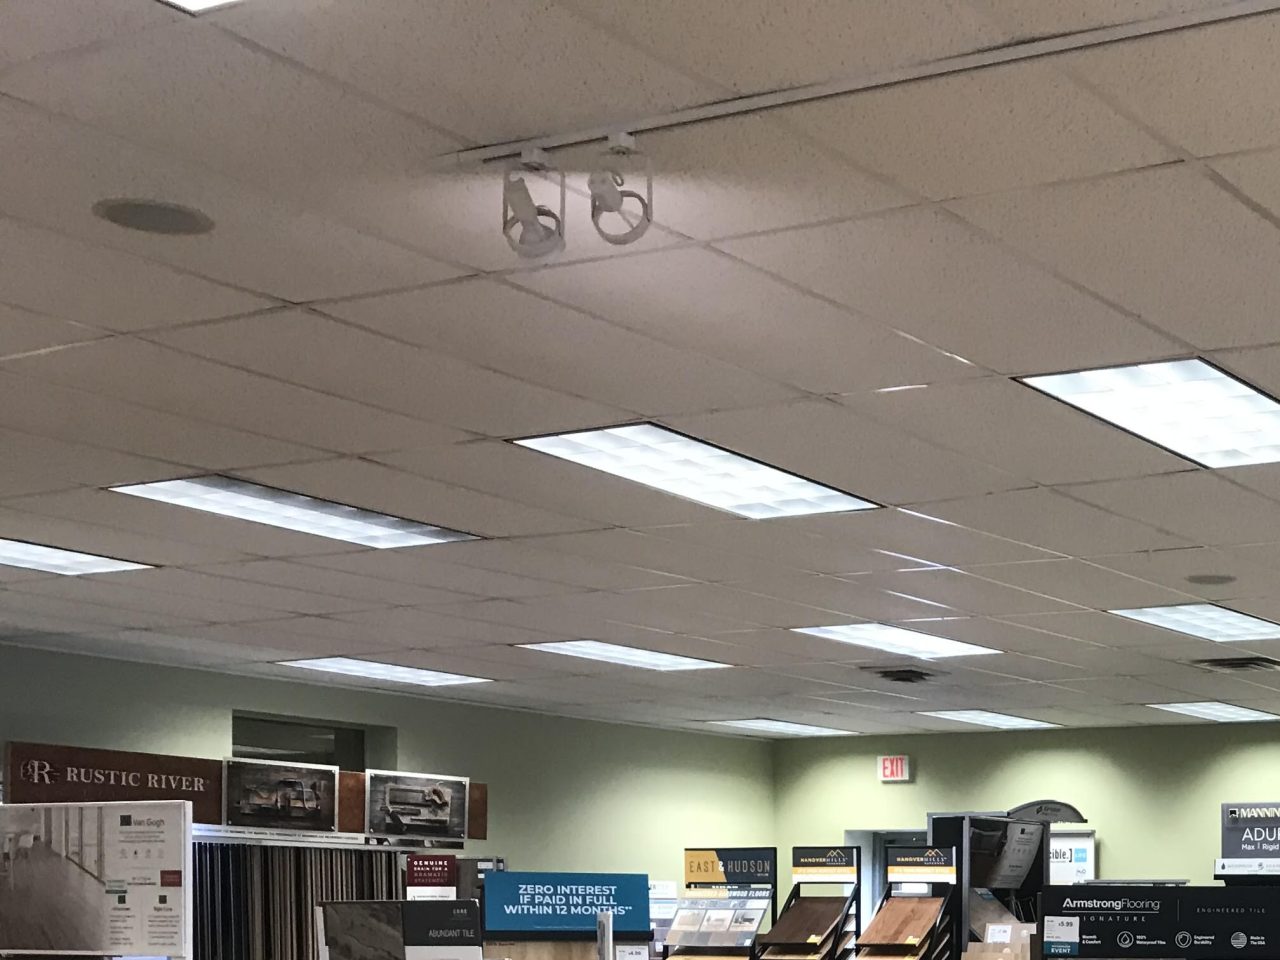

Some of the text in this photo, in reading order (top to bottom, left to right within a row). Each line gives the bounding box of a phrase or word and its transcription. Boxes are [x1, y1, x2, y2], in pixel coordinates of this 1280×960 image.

[882, 757, 905, 778] EXIT
[66, 767, 141, 787] RUSTIC
[147, 773, 205, 792] RIVER
[1262, 843, 1279, 851] Rigid
[690, 860, 770, 873] EAST & HUDSON
[518, 884, 617, 895] ZERO INTEREST
[519, 895, 617, 905] IF PAID IN FULL
[504, 905, 553, 915] WITHIN
[555, 906, 568, 915] 12
[429, 929, 475, 938] ABUNDANT TILE
